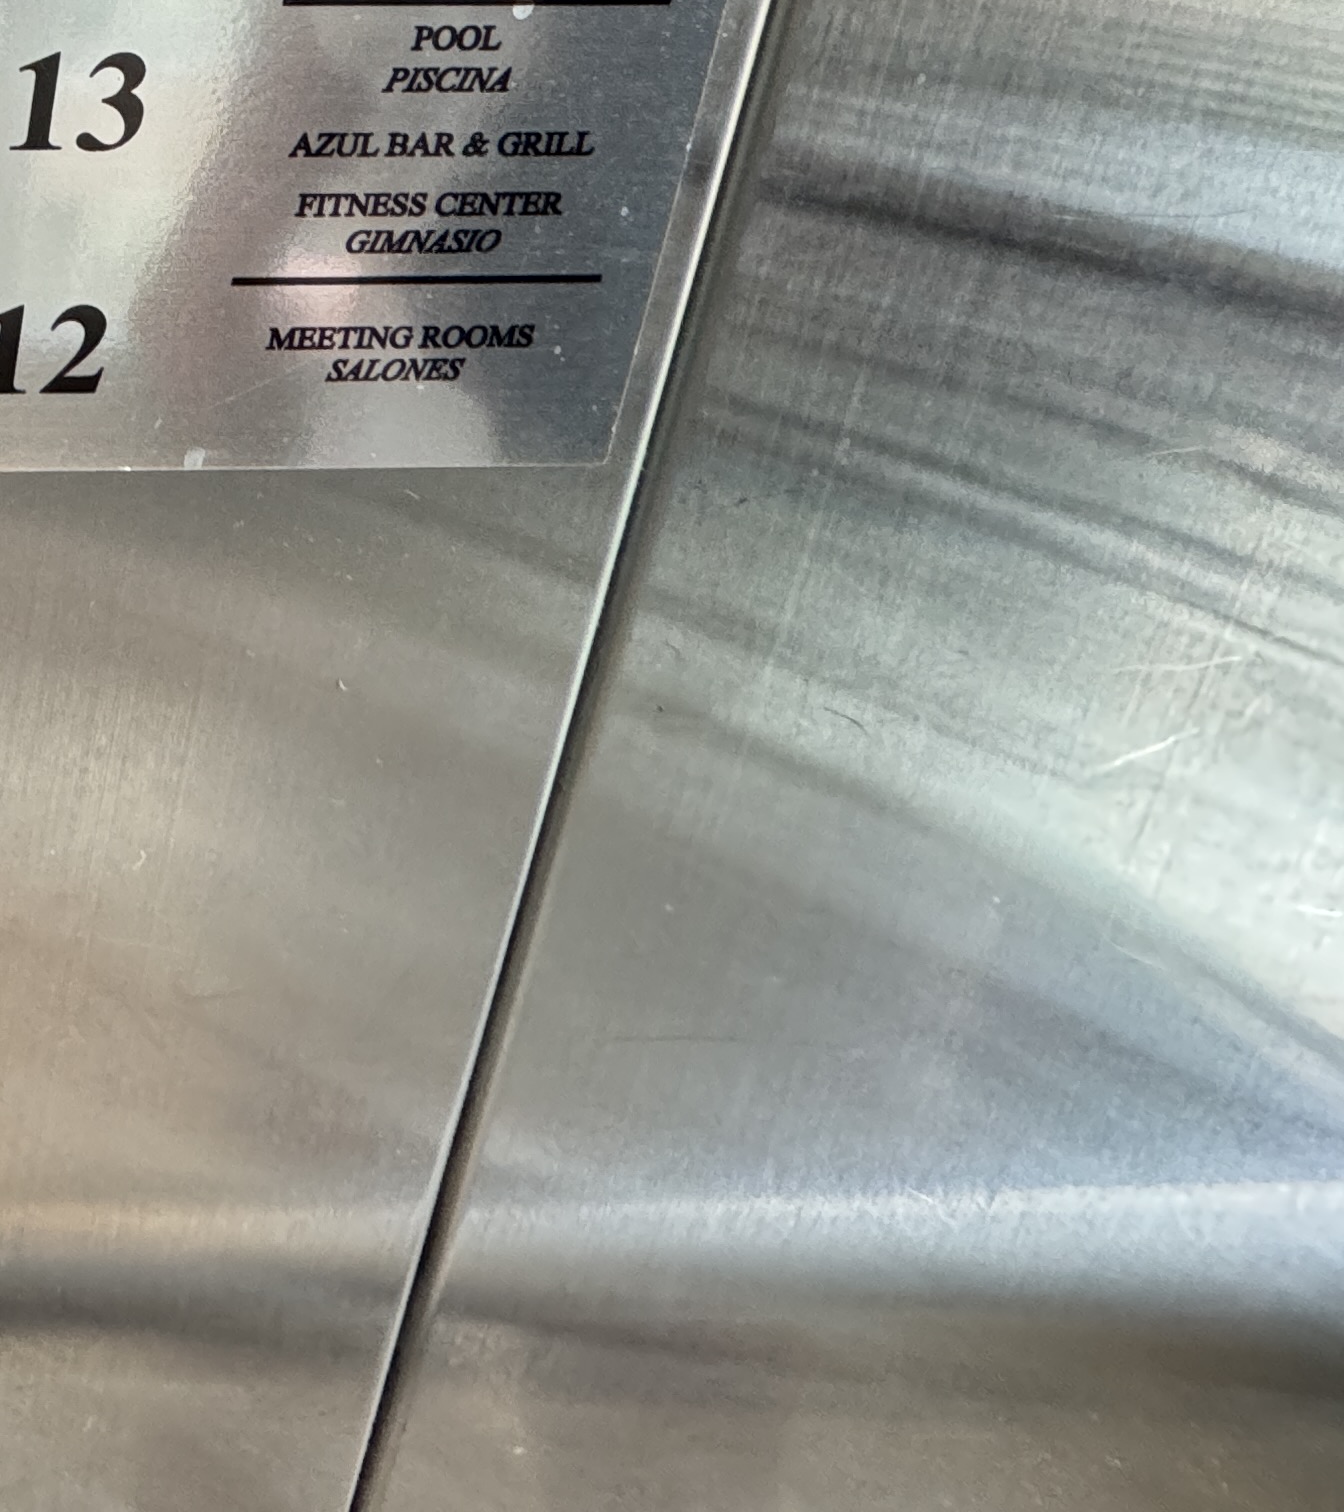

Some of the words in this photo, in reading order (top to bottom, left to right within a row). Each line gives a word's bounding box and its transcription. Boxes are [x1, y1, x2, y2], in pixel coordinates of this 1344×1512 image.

[411, 24, 503, 53] POOL
[382, 67, 513, 94] PISCINA
[9, 51, 148, 152] 13
[288, 131, 381, 158] AZUL
[383, 131, 458, 158] BAR
[460, 131, 491, 158] &
[499, 131, 595, 158] GRILL
[294, 191, 428, 219] FITNESS
[434, 191, 564, 218] CENTER
[344, 228, 503, 255] GIMNASIO
[265, 325, 414, 352] MEETING
[418, 324, 535, 352] ROOMS
[325, 357, 466, 383] SALONES
